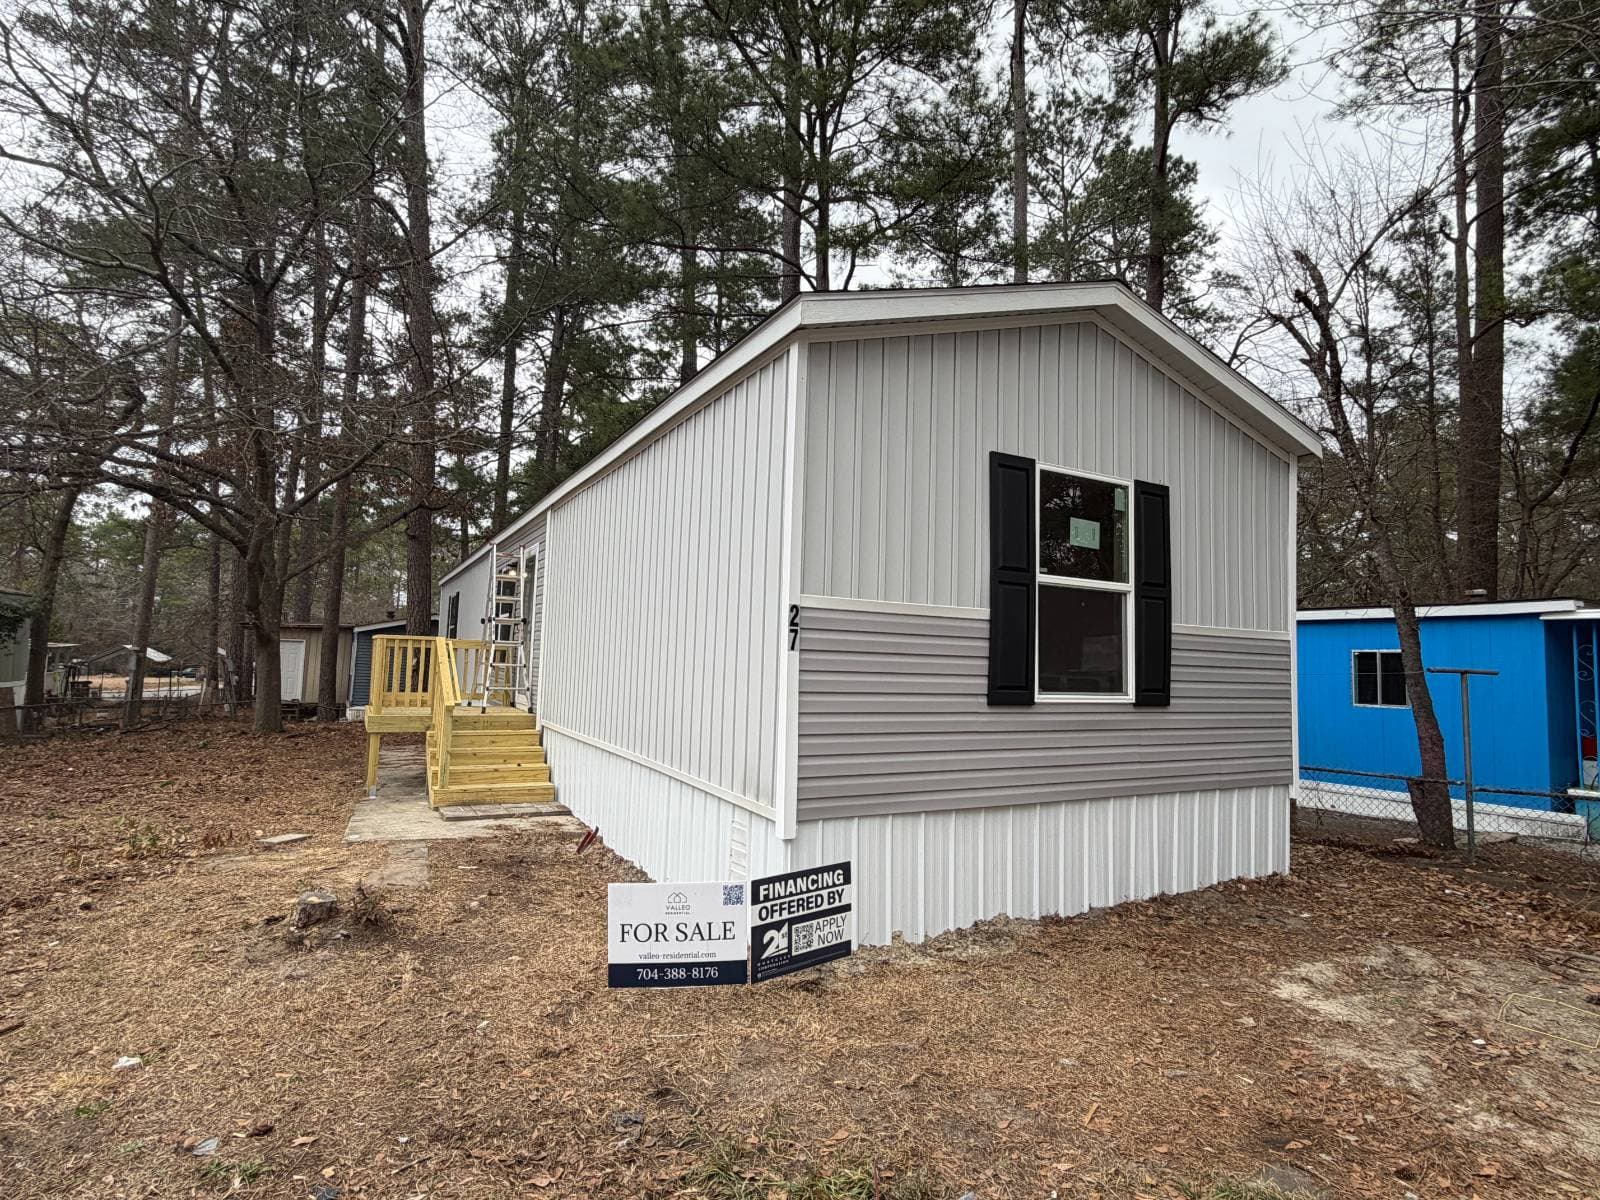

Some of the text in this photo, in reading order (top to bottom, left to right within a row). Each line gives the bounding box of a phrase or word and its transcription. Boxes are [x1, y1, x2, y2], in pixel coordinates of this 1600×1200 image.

[790, 604, 799, 651] 27
[760, 869, 844, 901] FINANCING
[758, 888, 845, 921] OFFERED BY
[619, 921, 736, 943] FOR SALE
[814, 914, 847, 934] APPLY
[817, 928, 844, 946] NOW
[638, 951, 717, 960] valleo-residential.com
[636, 966, 719, 980] 704-388-8176
